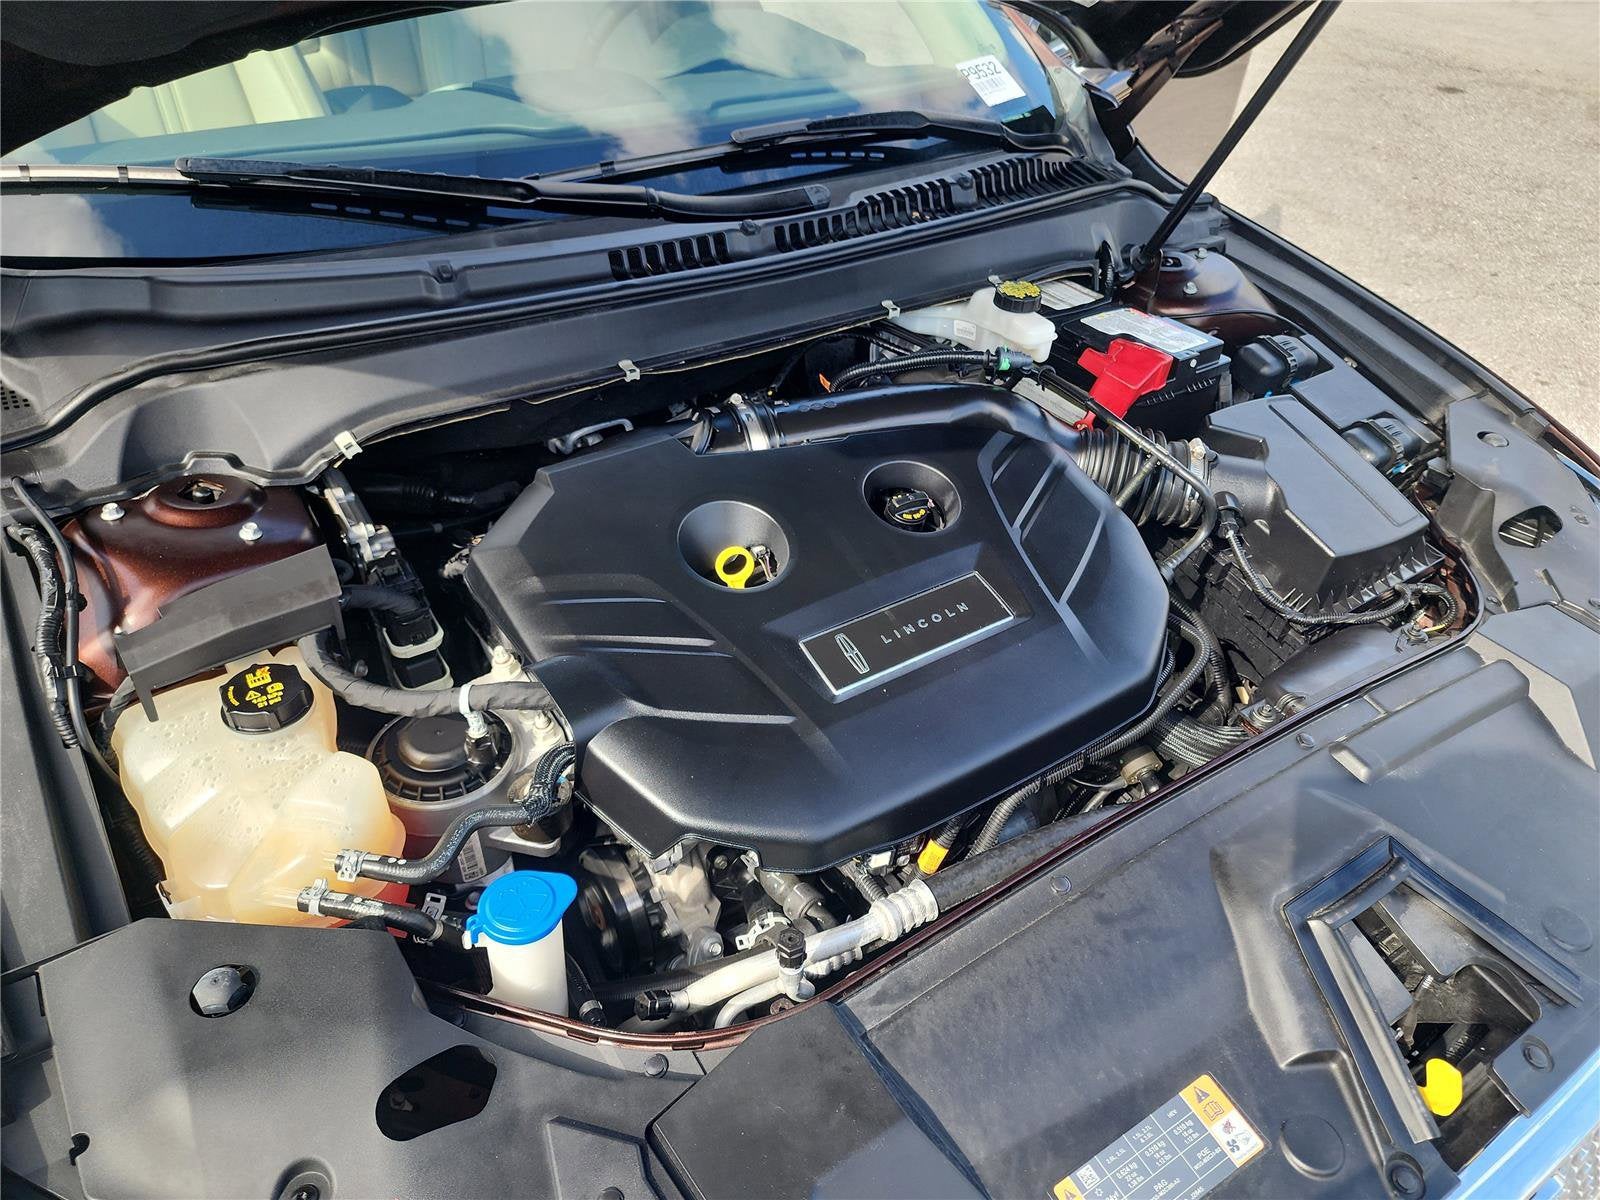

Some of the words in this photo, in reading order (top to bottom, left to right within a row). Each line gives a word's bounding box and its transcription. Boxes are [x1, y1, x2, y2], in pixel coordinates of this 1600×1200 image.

[960, 61, 1001, 79] P9532
[880, 602, 969, 644] LINCOLN
[1153, 1179, 1168, 1192] PAG
